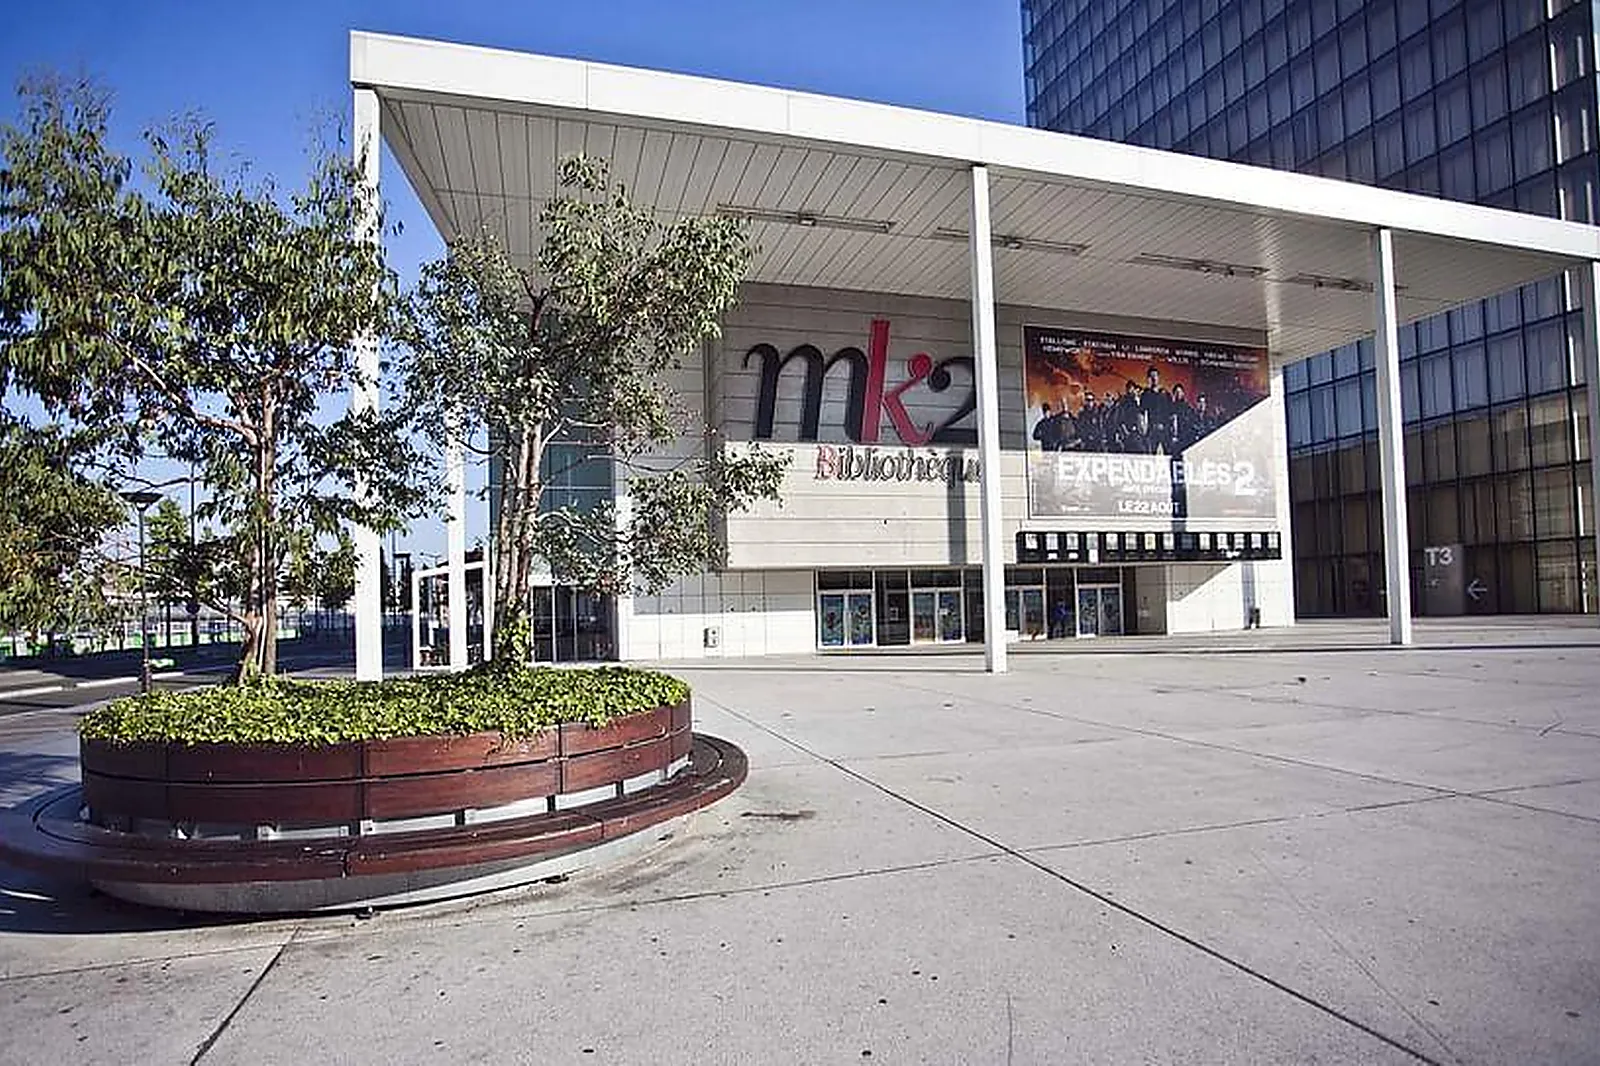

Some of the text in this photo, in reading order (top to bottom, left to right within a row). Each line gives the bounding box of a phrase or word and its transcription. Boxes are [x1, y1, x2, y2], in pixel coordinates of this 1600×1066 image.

[744, 318, 981, 446] mk2
[815, 445, 982, 486] Bibliothèqu
[1058, 446, 1257, 496] EXPENDABLES 2
[1423, 547, 1453, 566] T3
